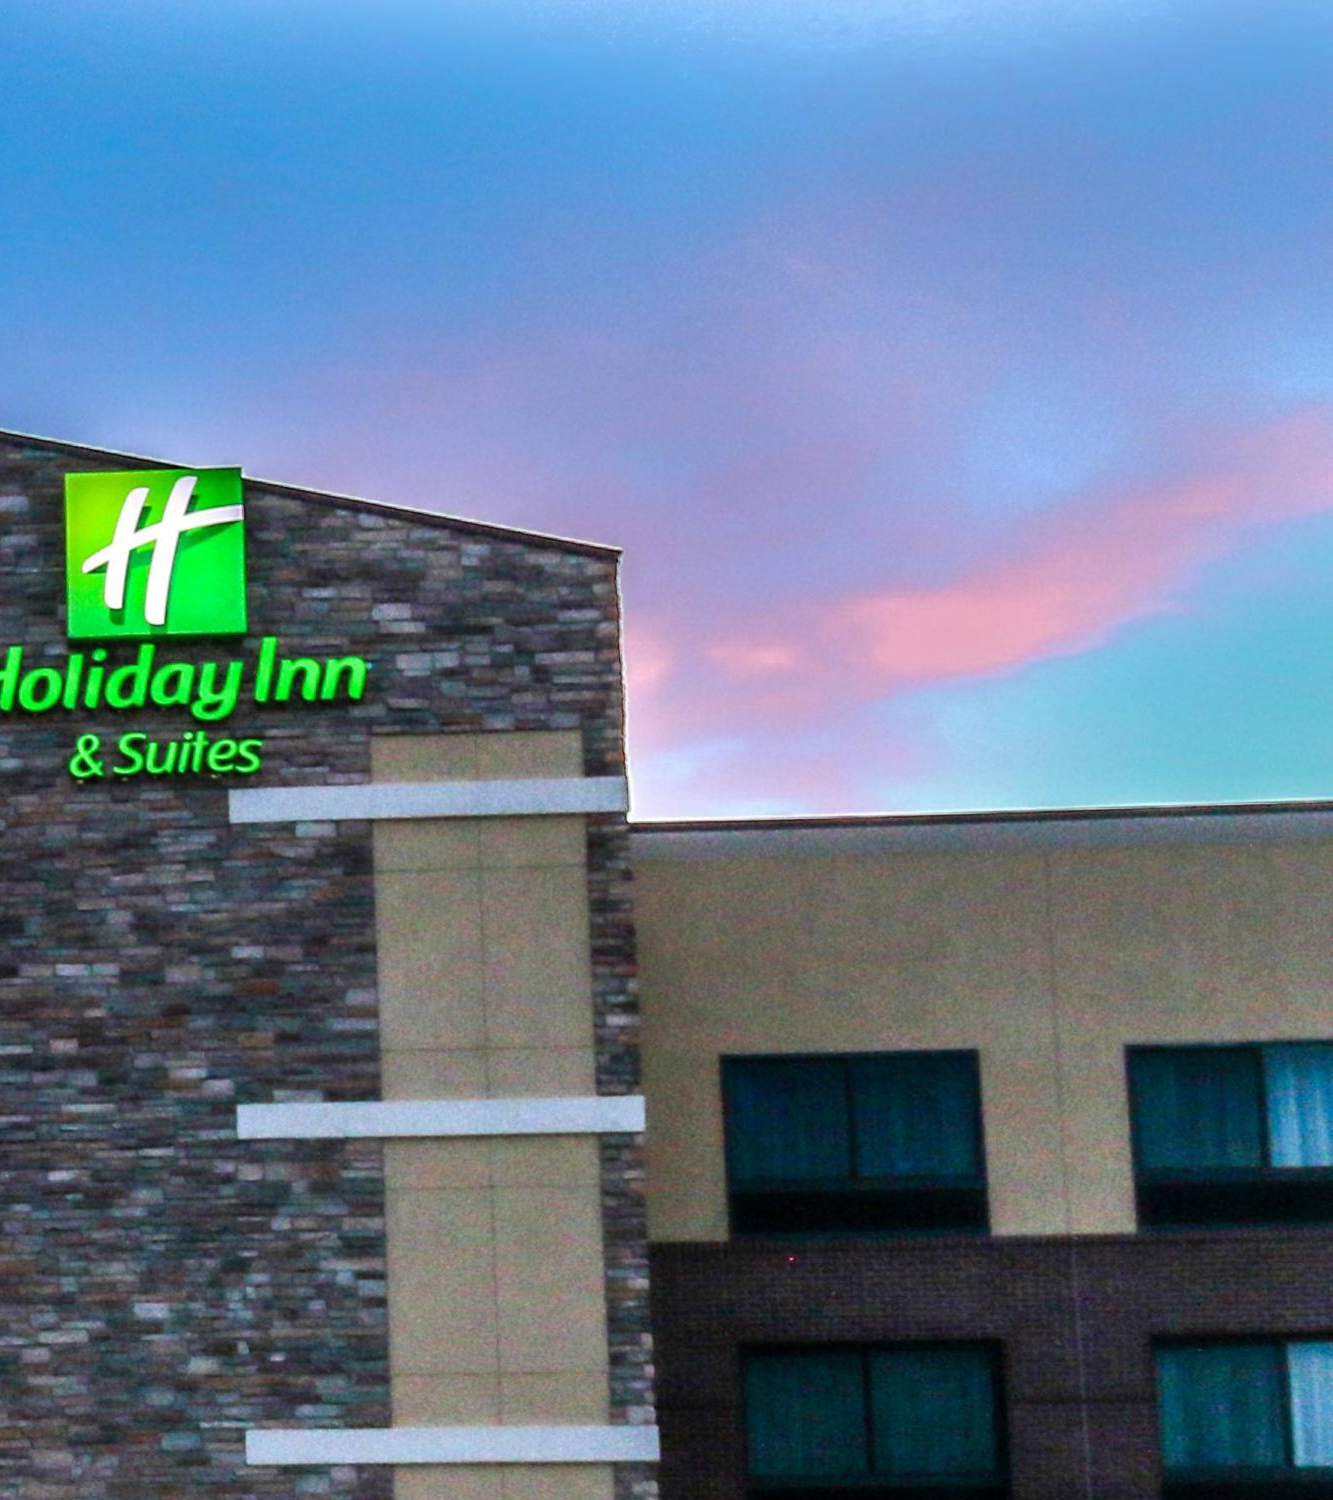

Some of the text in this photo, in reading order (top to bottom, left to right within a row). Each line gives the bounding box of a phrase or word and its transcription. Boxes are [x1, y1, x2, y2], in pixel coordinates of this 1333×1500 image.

[82, 476, 244, 626] H
[254, 636, 367, 702] Inn
[69, 731, 263, 778] & Suites
